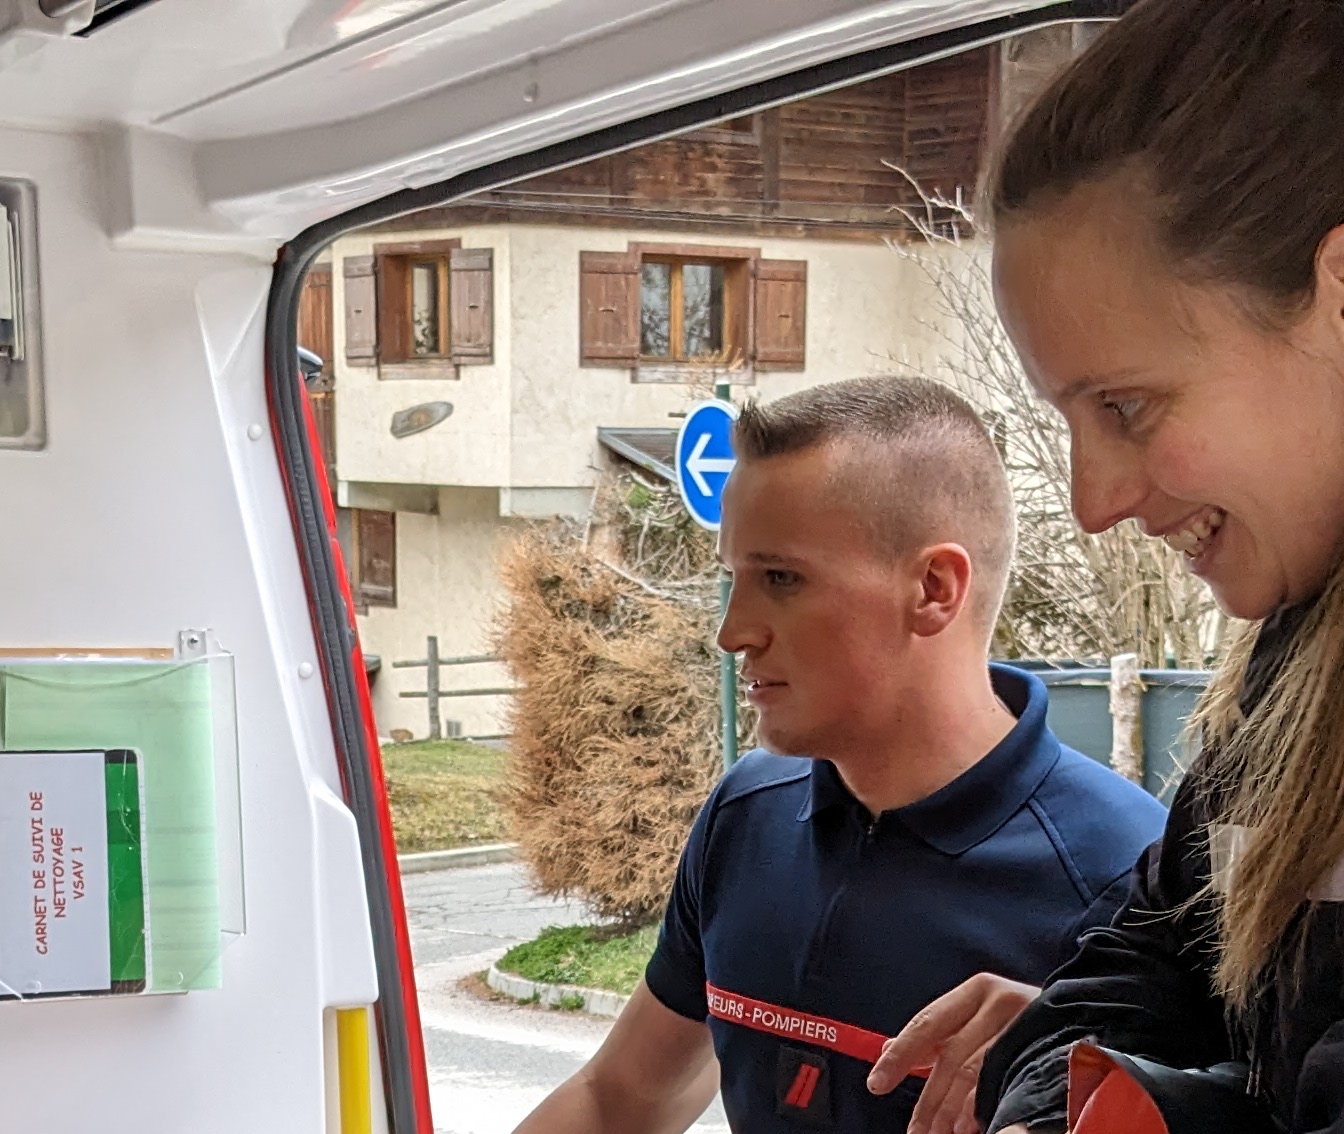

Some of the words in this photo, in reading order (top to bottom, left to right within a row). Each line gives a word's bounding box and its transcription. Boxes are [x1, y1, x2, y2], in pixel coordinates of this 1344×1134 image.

[29, 791, 43, 811] DE
[31, 817, 45, 864] SUIVI
[33, 869, 46, 890] DE
[50, 827, 67, 919] NETTOYAGE
[71, 860, 85, 900] VSAV
[34, 895, 48, 956] CARNET
